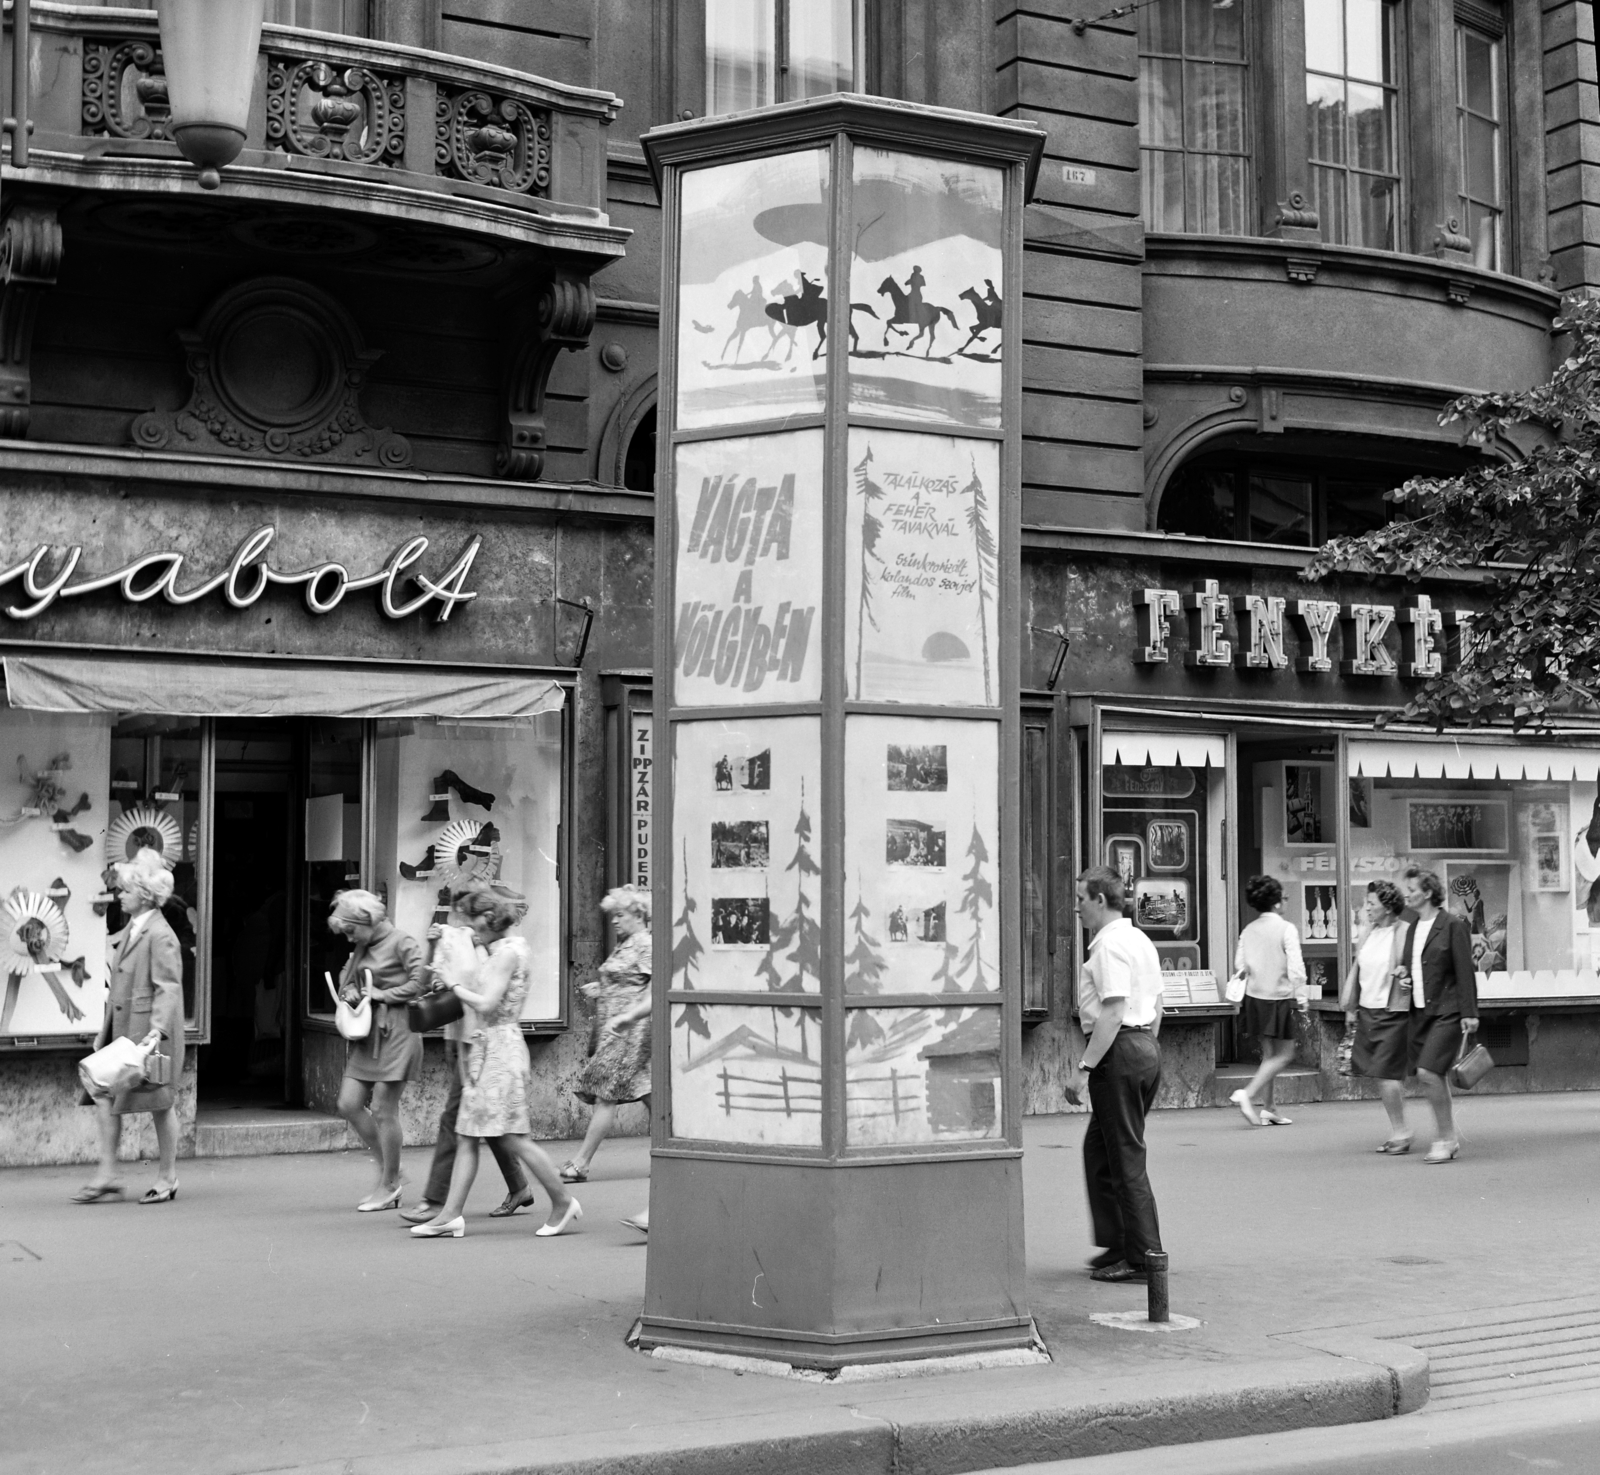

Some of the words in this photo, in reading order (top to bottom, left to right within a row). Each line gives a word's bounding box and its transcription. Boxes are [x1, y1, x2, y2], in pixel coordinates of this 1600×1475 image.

[883, 471, 959, 498] TALÁLKOZÁS
[910, 491, 920, 506] A
[687, 473, 796, 567] VÁGTA
[883, 502, 937, 523] FEHÉR
[891, 518, 959, 540] TAVAKNÁL
[0, 523, 484, 622] yabolt
[732, 569, 753, 604] A
[675, 600, 816, 693] VÖLGYBEN
[633, 729, 653, 812] ZIPPZÁR
[637, 819, 649, 887] PUDER
